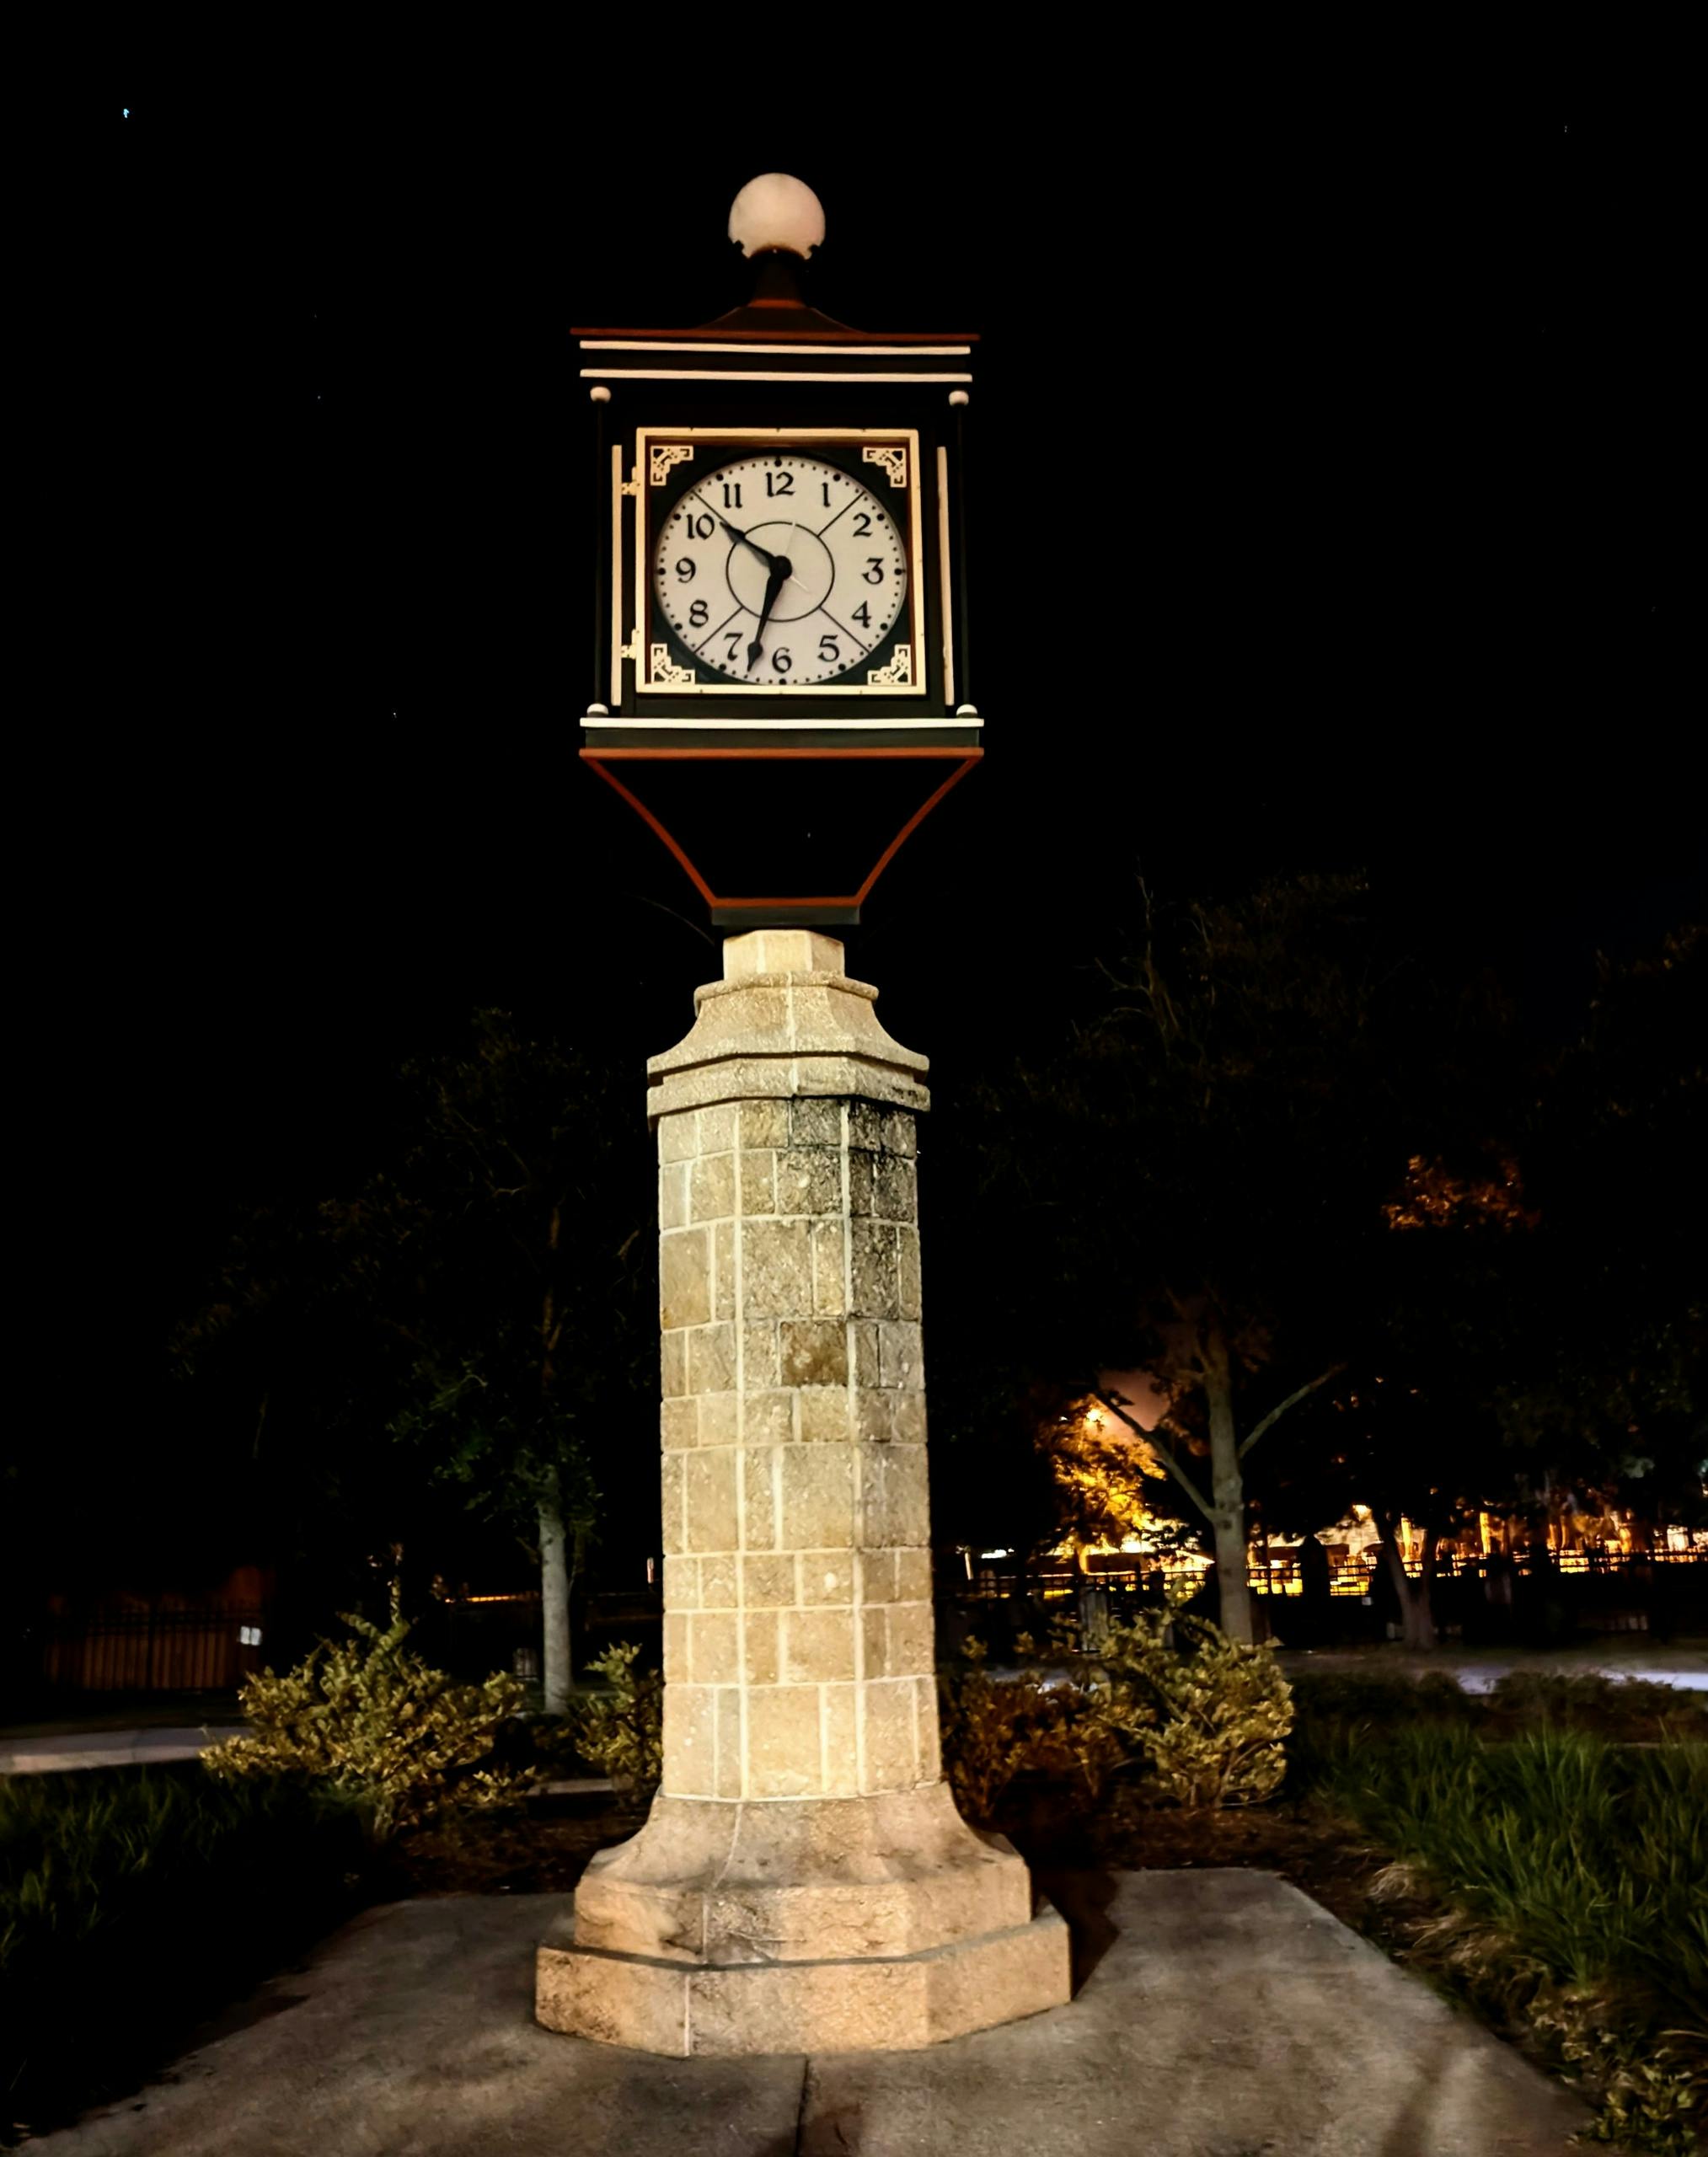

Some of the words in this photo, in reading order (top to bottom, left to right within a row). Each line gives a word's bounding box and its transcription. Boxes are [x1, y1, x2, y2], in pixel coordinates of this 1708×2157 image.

[722, 483, 742, 508] 11
[766, 472, 795, 498] 12
[822, 483, 831, 507] 1
[686, 513, 715, 540] 10
[853, 512, 872, 538] 2
[676, 557, 696, 583] 9
[861, 558, 884, 585] 3
[689, 600, 709, 628] 8
[851, 601, 871, 629] 4
[724, 633, 743, 661] 7
[772, 647, 792, 673] 6
[818, 634, 839, 661] 5
